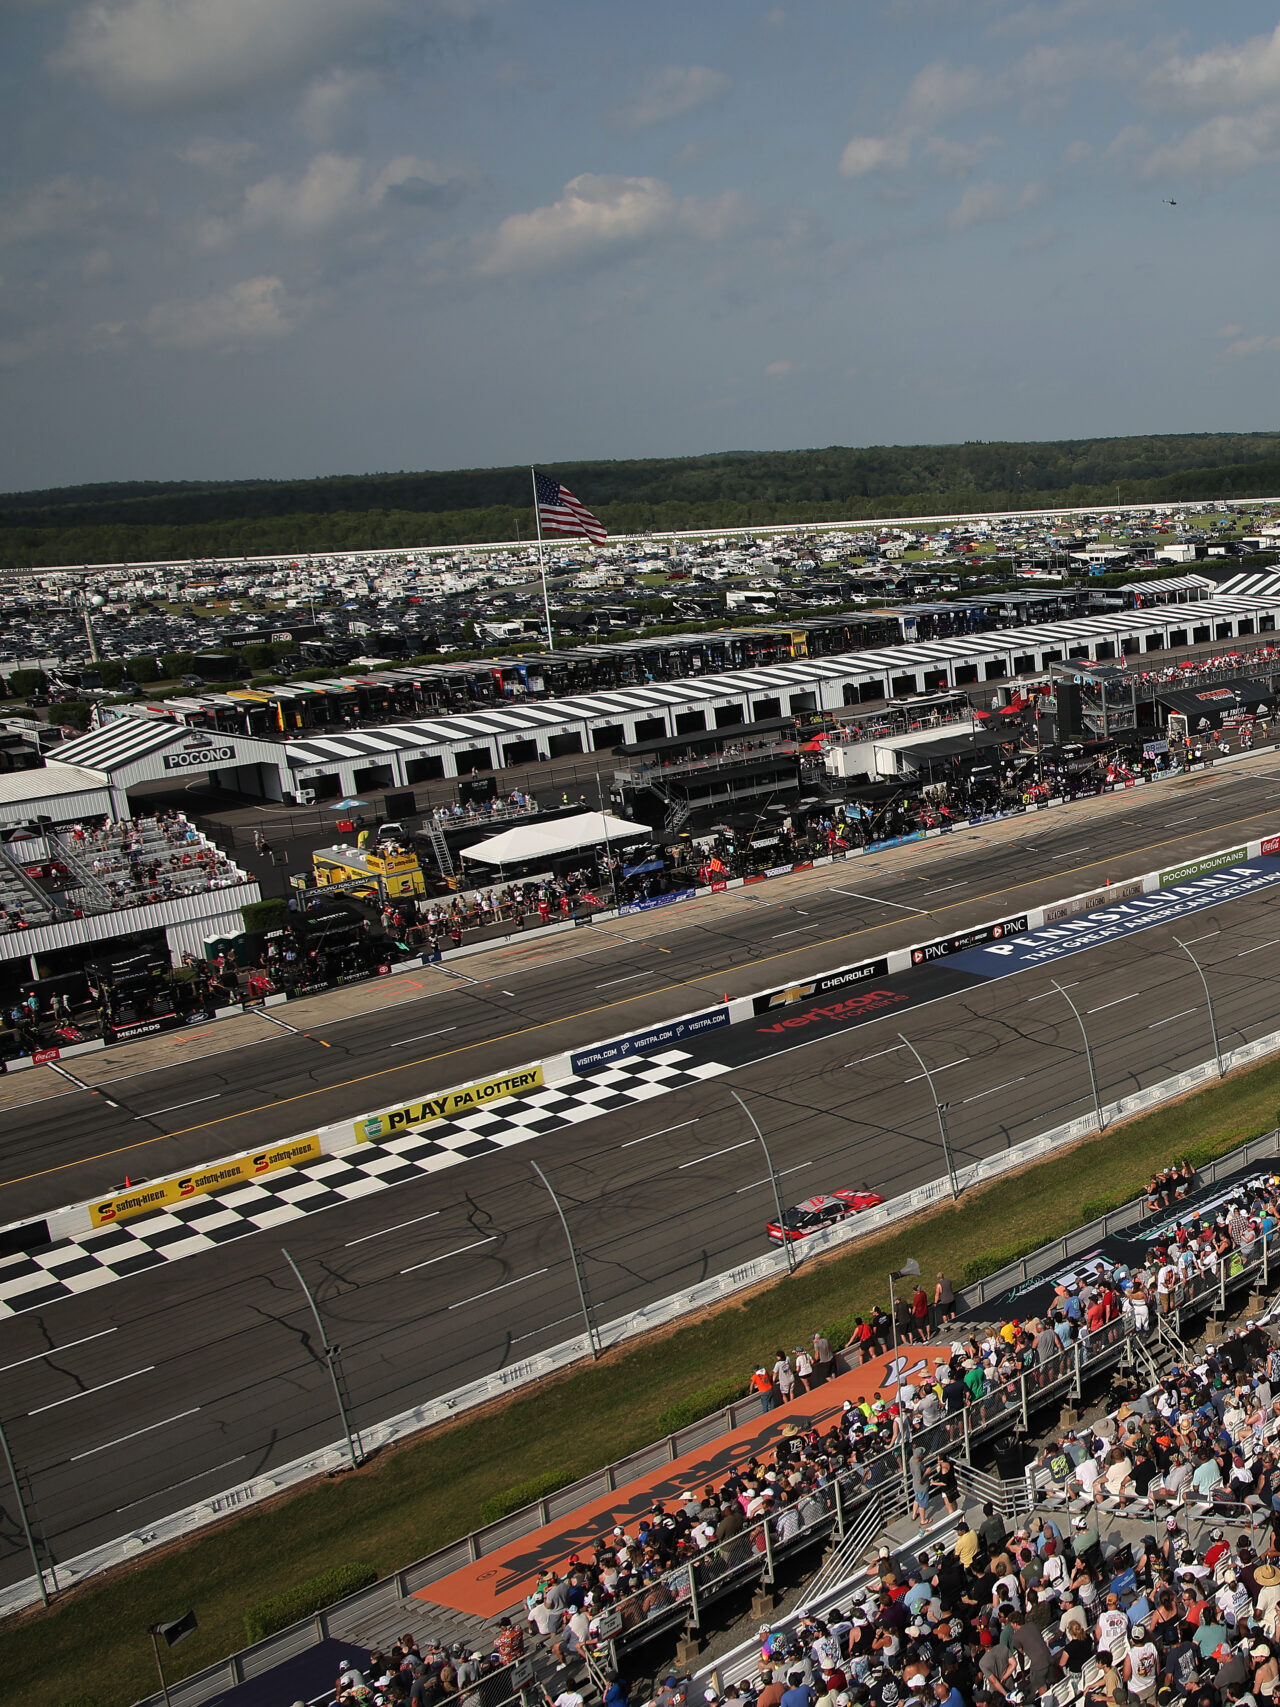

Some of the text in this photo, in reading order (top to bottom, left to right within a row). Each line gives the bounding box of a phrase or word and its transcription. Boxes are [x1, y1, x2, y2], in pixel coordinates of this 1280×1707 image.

[1142, 751, 1155, 759] 48
[1218, 743, 1230, 753] 42
[169, 748, 231, 768] POCONO
[838, 824, 844, 836] 7
[1262, 838, 1279, 852] Coca-Cola
[712, 860, 720, 870] 60
[765, 864, 793, 878] DORMAN
[1163, 851, 1243, 883] POCONO MOUNTAINS
[309, 884, 338, 895] POCONO
[983, 866, 1263, 956] PENNSYLVANIA
[264, 929, 284, 939] JGR
[1003, 919, 1026, 935] PNC
[1020, 946, 1060, 961] THE
[1062, 926, 1124, 950] GREAT
[1124, 897, 1213, 928] AMERICAN
[925, 942, 949, 960] PNC
[821, 966, 875, 989] CHEVROLET
[756, 989, 897, 1035] verizon
[829, 994, 911, 1022] frontline
[117, 1023, 161, 1039] MENARDS
[688, 1014, 726, 1031] VISITPA.COM
[634, 1030, 673, 1048] VISITPA.COM
[35, 1050, 57, 1062] Coca-Cola
[576, 1048, 618, 1066] VISITPA.COM
[388, 1070, 537, 1130] PLAY PA LOTTERY
[269, 1143, 313, 1165] safety-kleen
[195, 1166, 243, 1188] safety-kleen
[116, 1189, 167, 1213] safety-kleen
